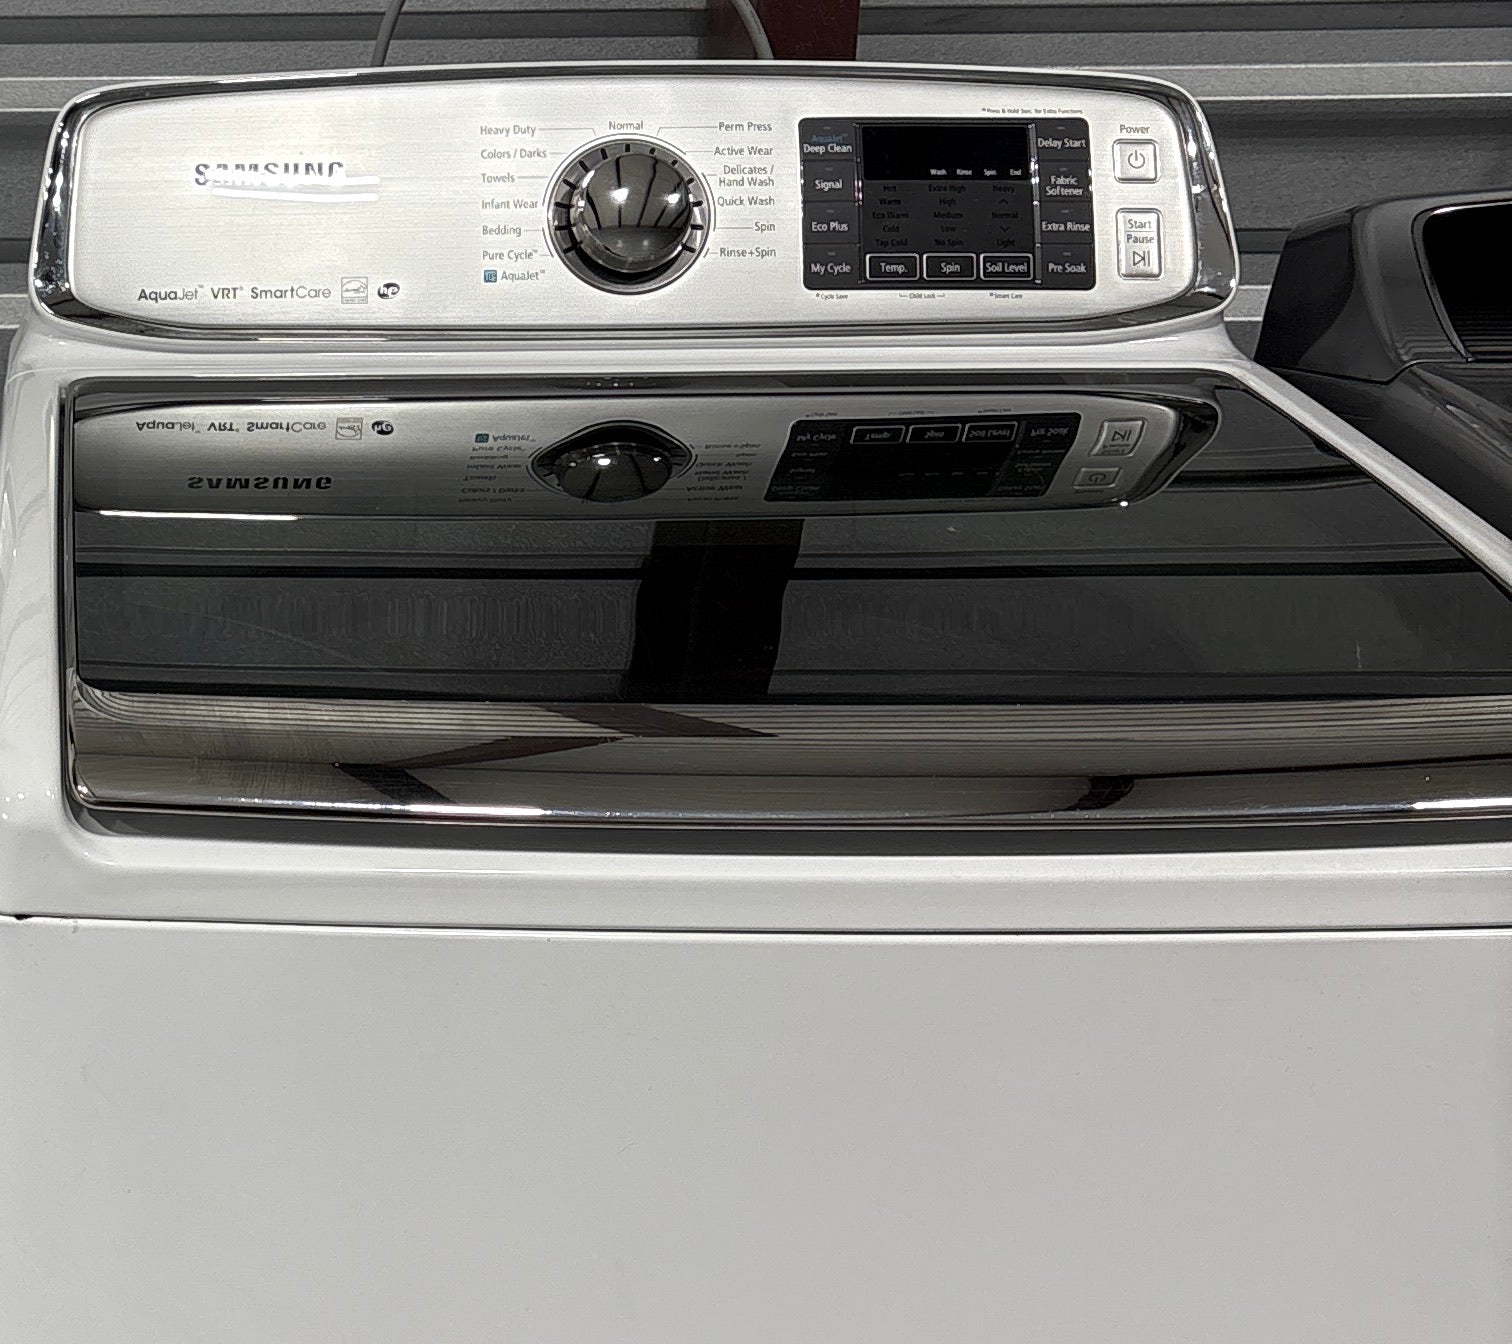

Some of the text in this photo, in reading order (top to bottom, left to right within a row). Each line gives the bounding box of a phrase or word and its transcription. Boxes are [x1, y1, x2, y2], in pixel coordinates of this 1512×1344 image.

[480, 124, 536, 137] Heavy Duty
[608, 120, 643, 131] Normal
[718, 121, 773, 132] Perm Press
[1119, 124, 1150, 134] Power
[1037, 137, 1086, 149] Delay Start
[480, 148, 511, 159] Colors
[519, 148, 548, 159] Darks
[714, 145, 774, 156] Active Wear
[803, 143, 853, 155] Deep Clean
[723, 164, 768, 175] Delicates
[1009, 168, 1022, 176] End
[481, 172, 515, 183] Towels
[718, 176, 775, 187] Hand Wash
[1050, 175, 1078, 185] Fabric
[814, 179, 843, 191] Signal
[1045, 185, 1083, 196] Softener
[481, 198, 538, 209] Infant Wear
[717, 195, 775, 207] Quick Wash
[754, 221, 776, 233] Spin
[811, 221, 849, 232] Eco Plus
[1041, 221, 1090, 232] Extra Rinse
[1127, 218, 1152, 229] Start
[482, 224, 522, 237] Bedding
[1126, 233, 1155, 244] Pause
[482, 250, 505, 260] Pure
[719, 246, 777, 259] Rinse+Spin
[810, 262, 852, 275] My Cycle
[880, 262, 907, 274] Temp.
[940, 262, 961, 275] Spin
[986, 262, 1028, 273] Soil Level
[1048, 262, 1086, 273] Pre Soak
[250, 285, 332, 300] SmartCare
